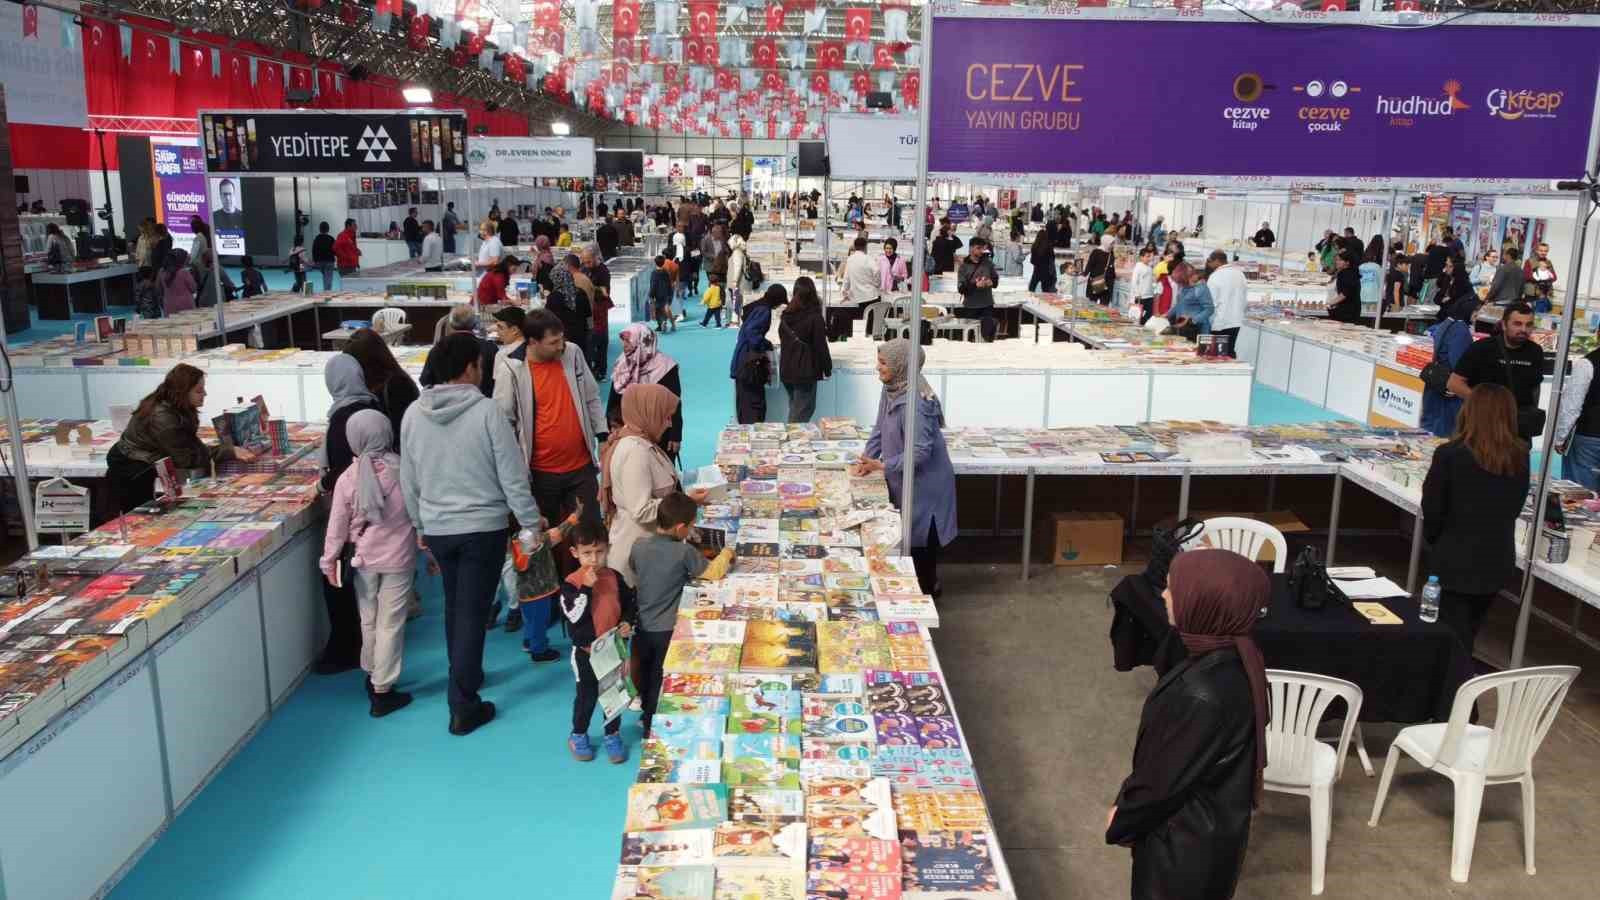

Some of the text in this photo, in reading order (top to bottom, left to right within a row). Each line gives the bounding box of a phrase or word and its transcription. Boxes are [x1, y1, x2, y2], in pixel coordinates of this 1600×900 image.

[966, 63, 1084, 101] CEZVE
[1223, 106, 1271, 119] cezve
[1298, 106, 1351, 120] cezve
[965, 111, 1081, 130] YAYIN GRUBU
[1232, 119, 1258, 131] kitap
[1307, 121, 1341, 133] çocuk
[271, 132, 351, 157] YEDİTEPE
